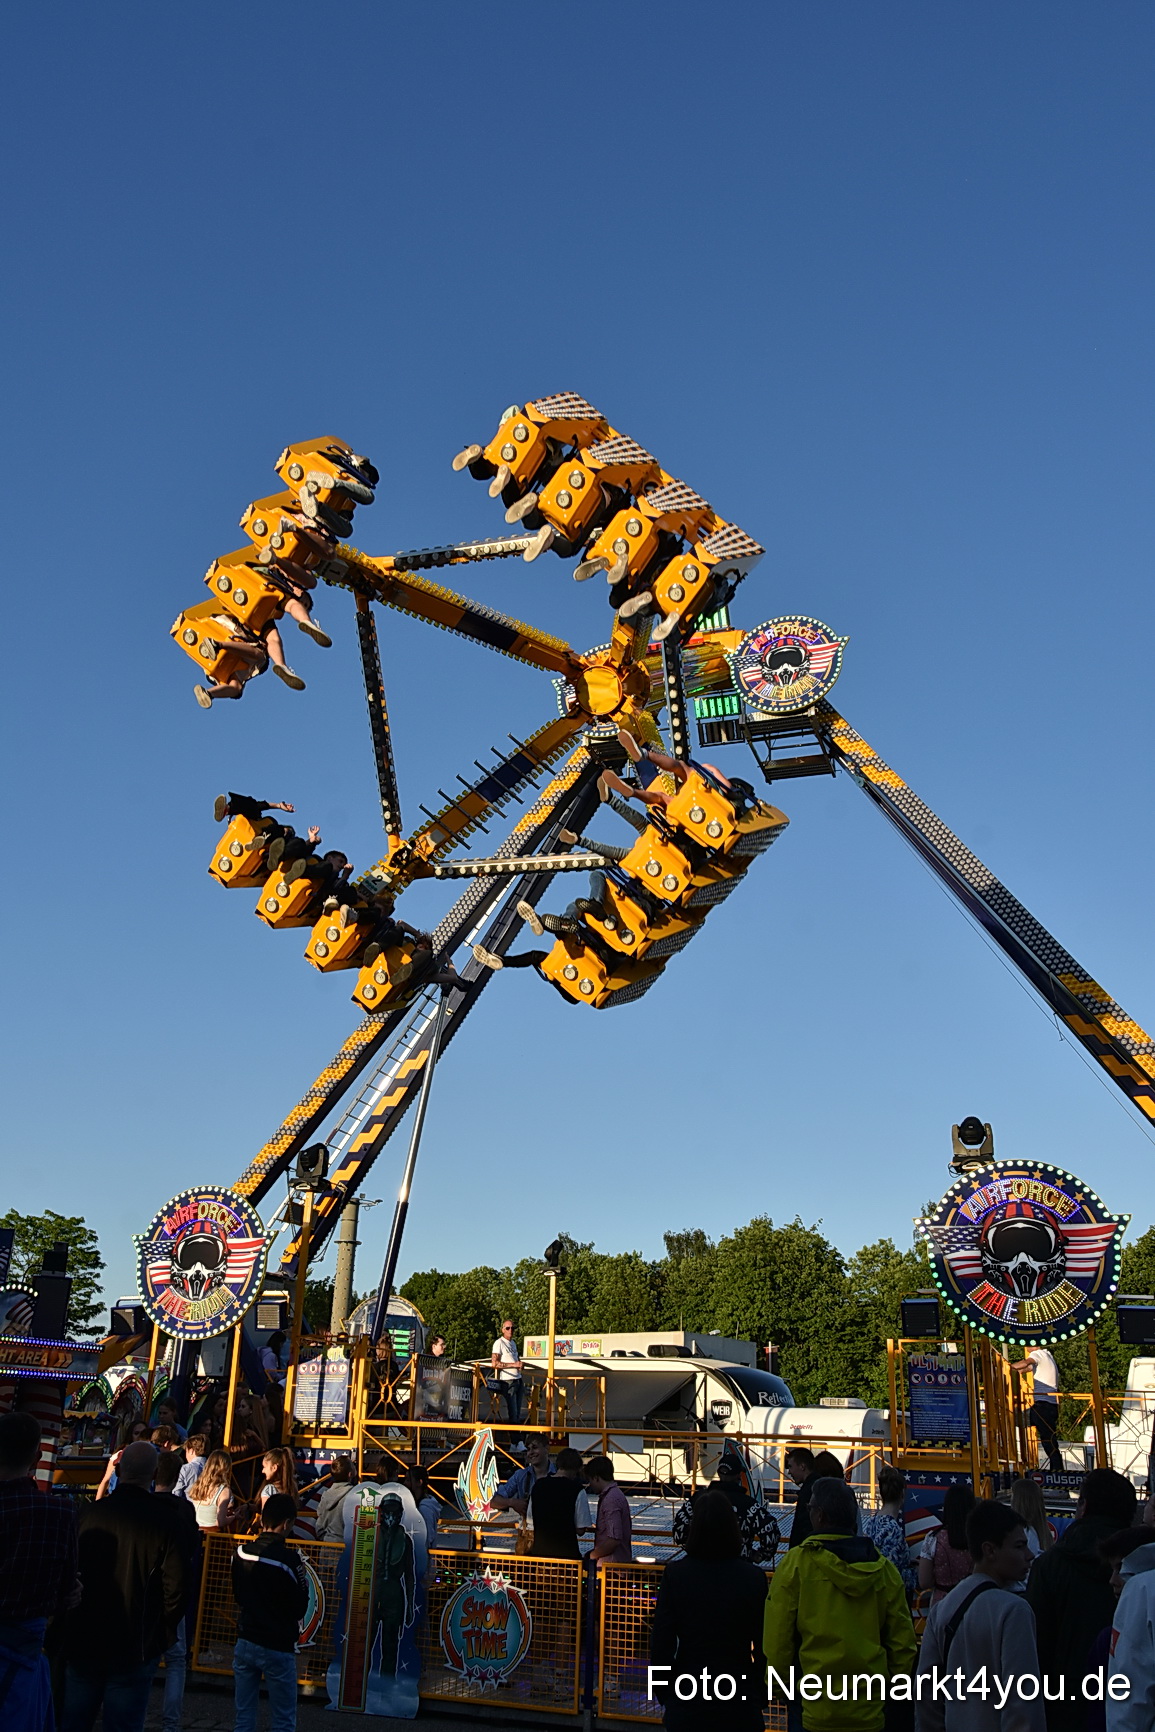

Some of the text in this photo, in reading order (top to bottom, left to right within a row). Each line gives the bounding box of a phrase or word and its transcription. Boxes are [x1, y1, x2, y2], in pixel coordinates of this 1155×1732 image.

[754, 624, 818, 650] AIRFORCE
[753, 680, 783, 700] THE
[967, 1179, 1074, 1217] AIRFORCE
[166, 1202, 240, 1236] AIRFORCE
[158, 1287, 234, 1320] THE RIDE
[973, 1282, 1082, 1322] THE RIDE
[17, 1350, 48, 1366] AREA
[911, 1354, 966, 1371] ULTIMAT
[451, 1386, 471, 1402] DANGER
[449, 1405, 463, 1420] ZONE
[460, 1595, 508, 1630] SHOW
